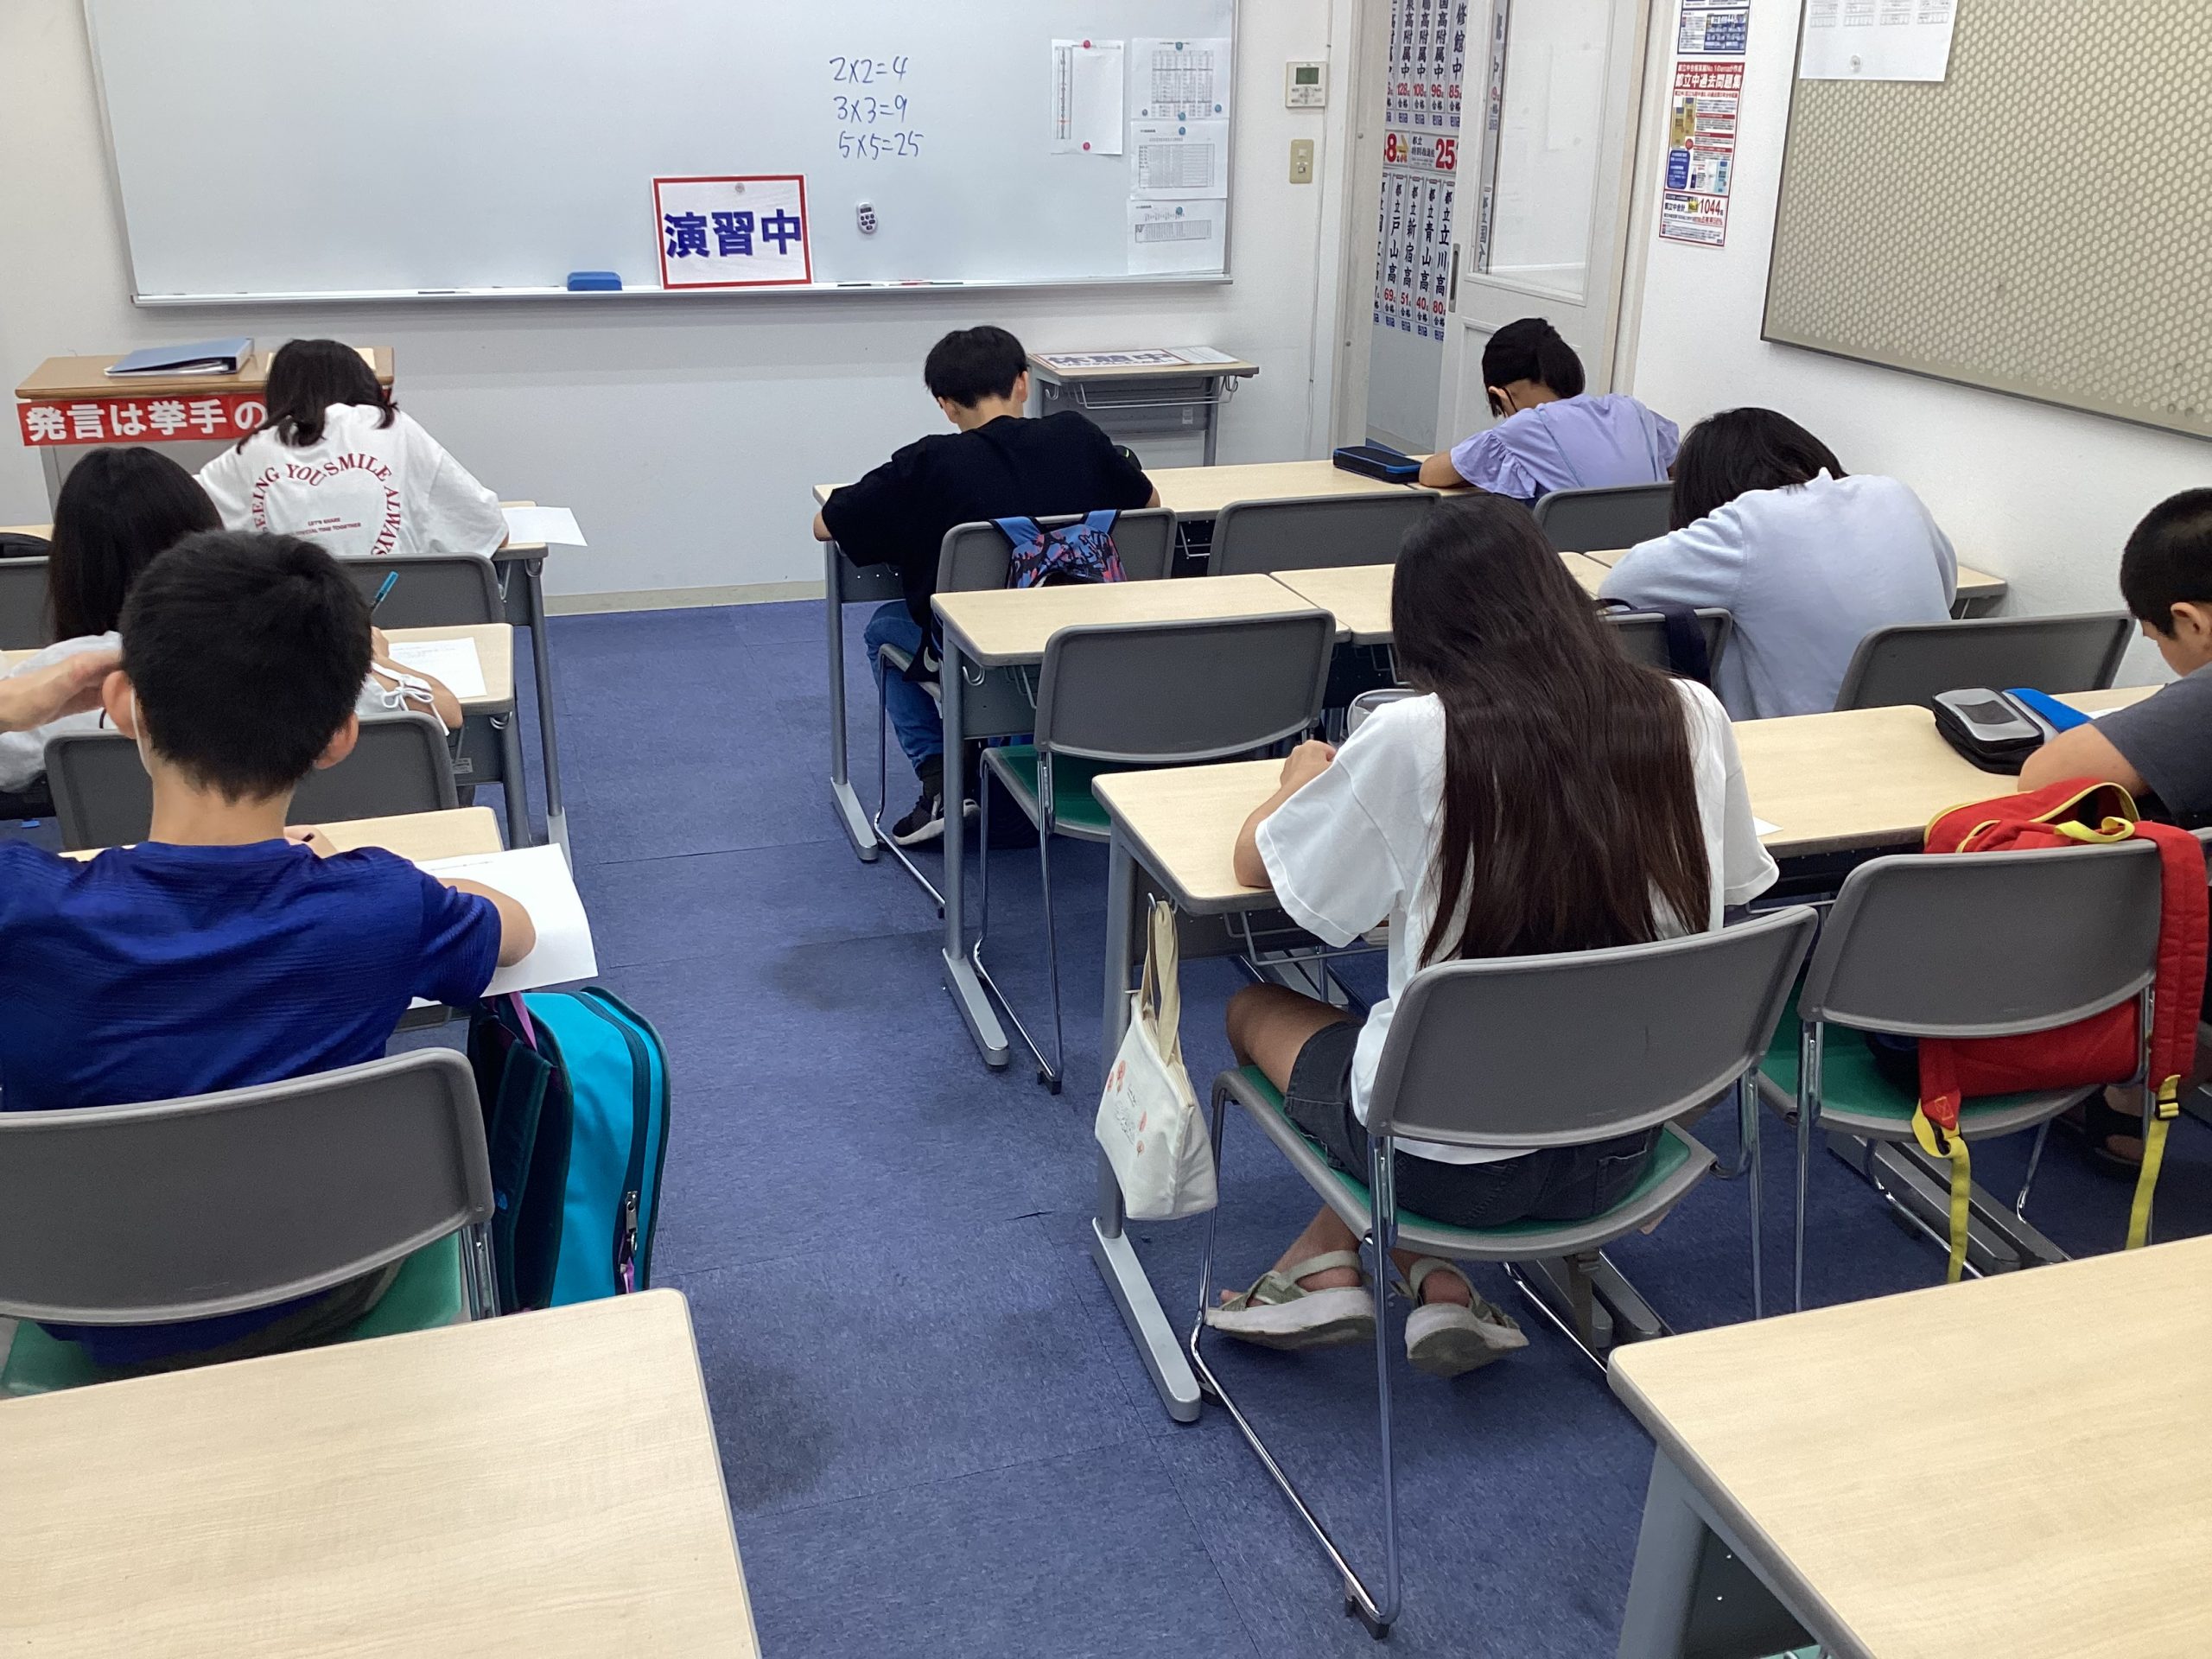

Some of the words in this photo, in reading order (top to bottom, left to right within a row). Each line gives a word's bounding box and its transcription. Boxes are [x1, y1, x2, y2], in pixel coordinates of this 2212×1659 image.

[664, 208, 802, 258] 演習中
[1388, 182, 1402, 284] 都立戸山高
[1403, 184, 1419, 289] 都立新宿高
[1420, 188, 1436, 293] 都立青山高
[1435, 189, 1453, 297] 都立立川高
[26, 398, 268, 442] 発言は挙手の
[285, 463, 327, 486] YOU
[323, 453, 392, 482] SMILE
